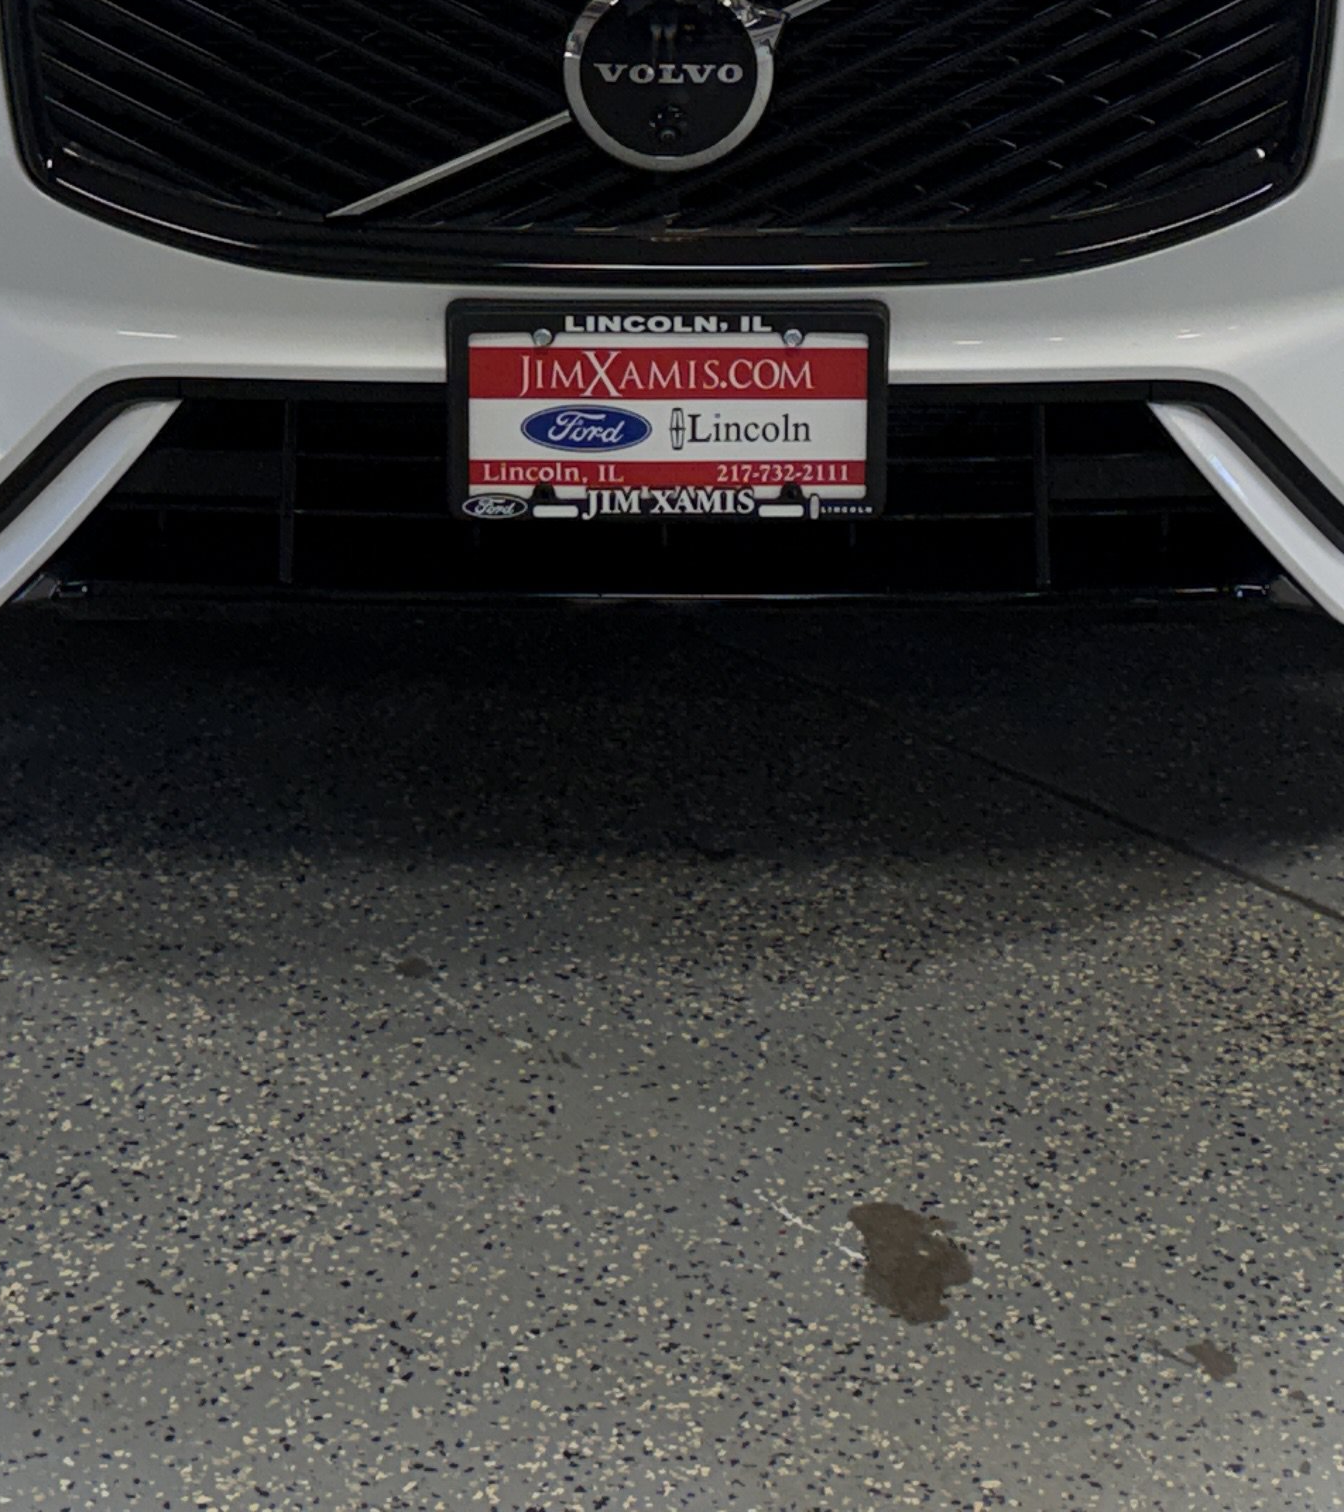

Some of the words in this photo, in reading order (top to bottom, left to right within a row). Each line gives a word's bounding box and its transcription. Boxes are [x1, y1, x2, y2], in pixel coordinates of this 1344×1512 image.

[593, 62, 744, 85] VOLVO
[564, 314, 730, 333] LINCOLN,
[740, 315, 773, 333] IL
[518, 350, 815, 398] JIMXAMIS.COM
[547, 410, 626, 444] Ford
[687, 413, 812, 443] Lincoln
[598, 464, 625, 483] IL
[716, 463, 849, 483] 217-732-2111
[474, 497, 517, 516] Ford
[581, 489, 642, 520] JIM
[650, 488, 755, 515] XAMIS
